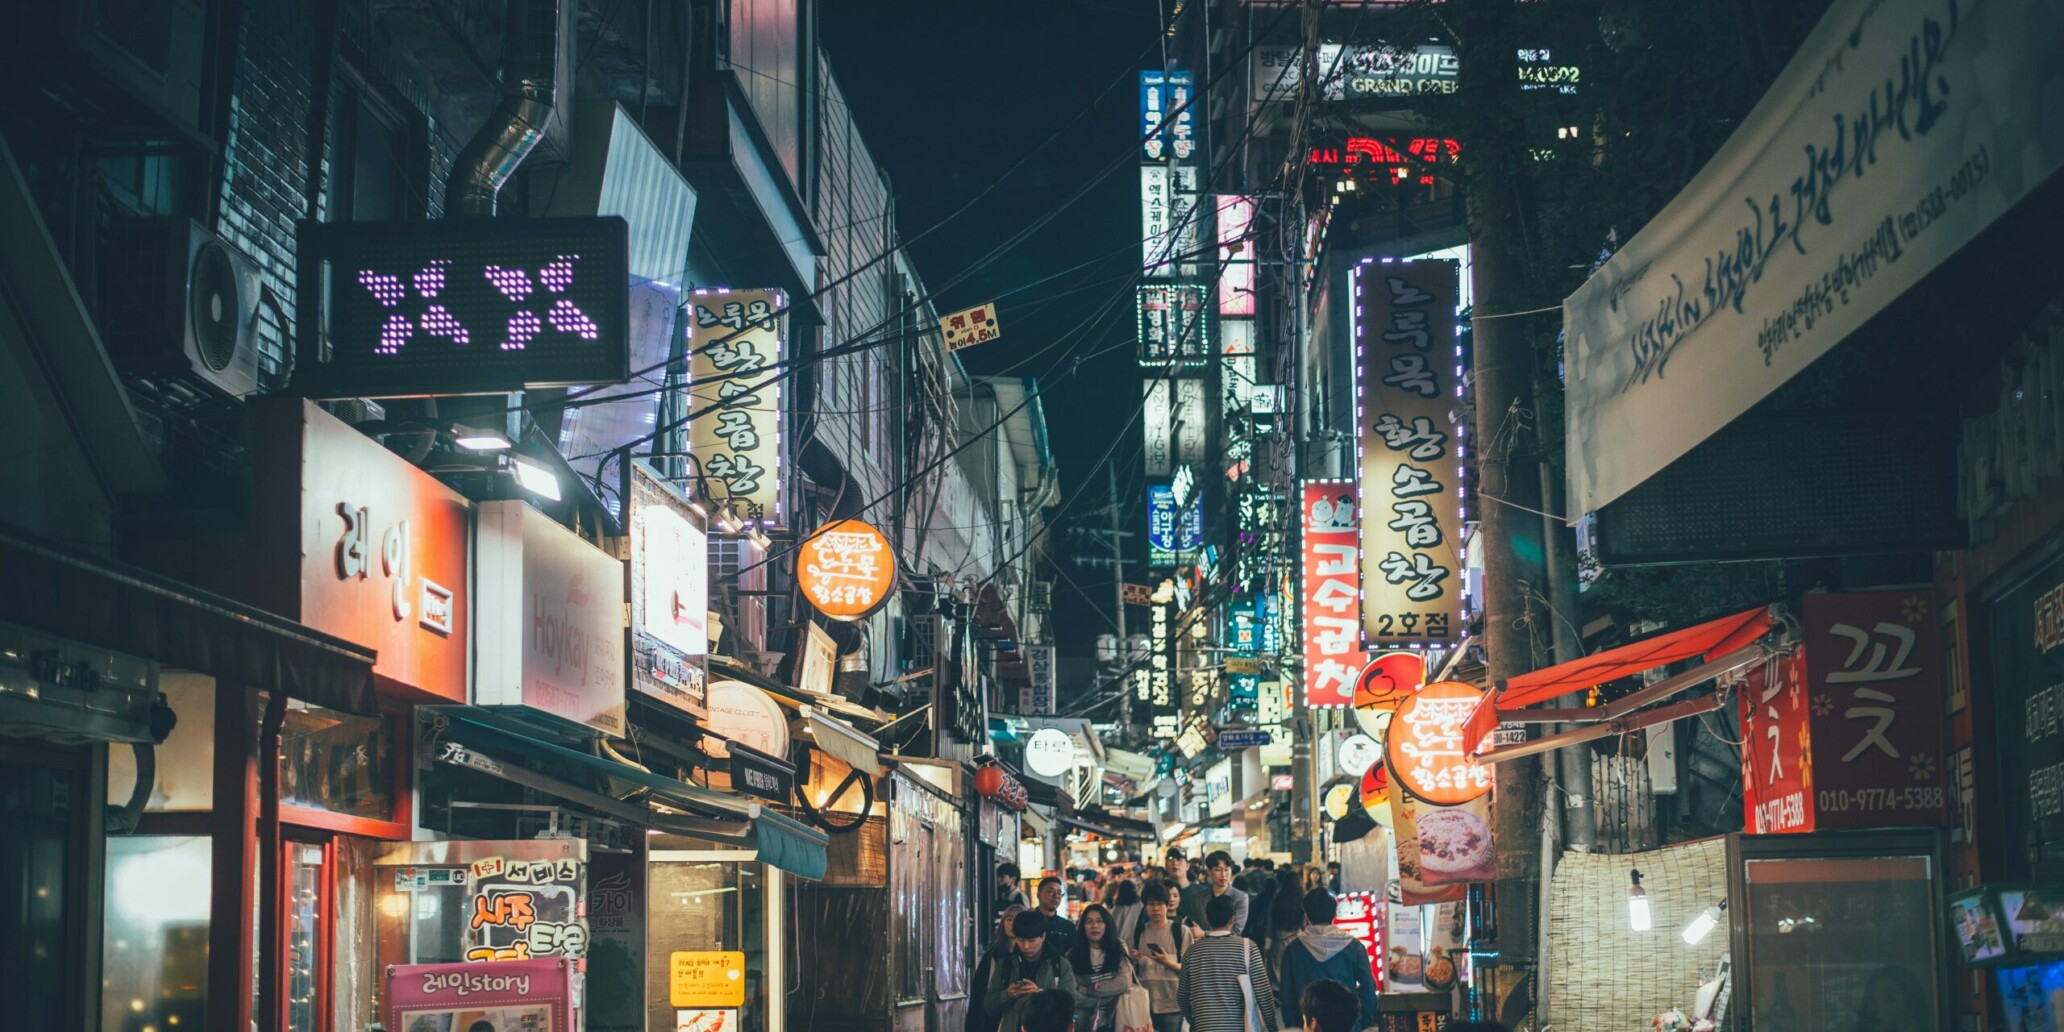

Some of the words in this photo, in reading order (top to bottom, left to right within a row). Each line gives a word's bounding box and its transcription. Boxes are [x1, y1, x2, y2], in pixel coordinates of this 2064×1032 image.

[695, 300, 776, 332] 노루목
[949, 308, 986, 329] 위험
[1382, 276, 1441, 399] 노루목
[704, 339, 766, 496] 황소곱창
[1373, 413, 1450, 602] 황소곱창
[1160, 511, 1174, 548] 야구장
[334, 502, 411, 622] 레인
[811, 584, 874, 605] 황소곱창
[1312, 543, 1359, 698] 교수곱창
[1378, 612, 1449, 638] 2호점
[533, 592, 589, 687] Hoykay
[1825, 621, 1922, 763] 꽃
[1034, 740, 1067, 753] 타로
[1410, 763, 1491, 792] 황소곱창
[1819, 787, 1944, 812] 010-9774-5388
[507, 861, 575, 883] 서비스
[471, 894, 536, 931] 사주
